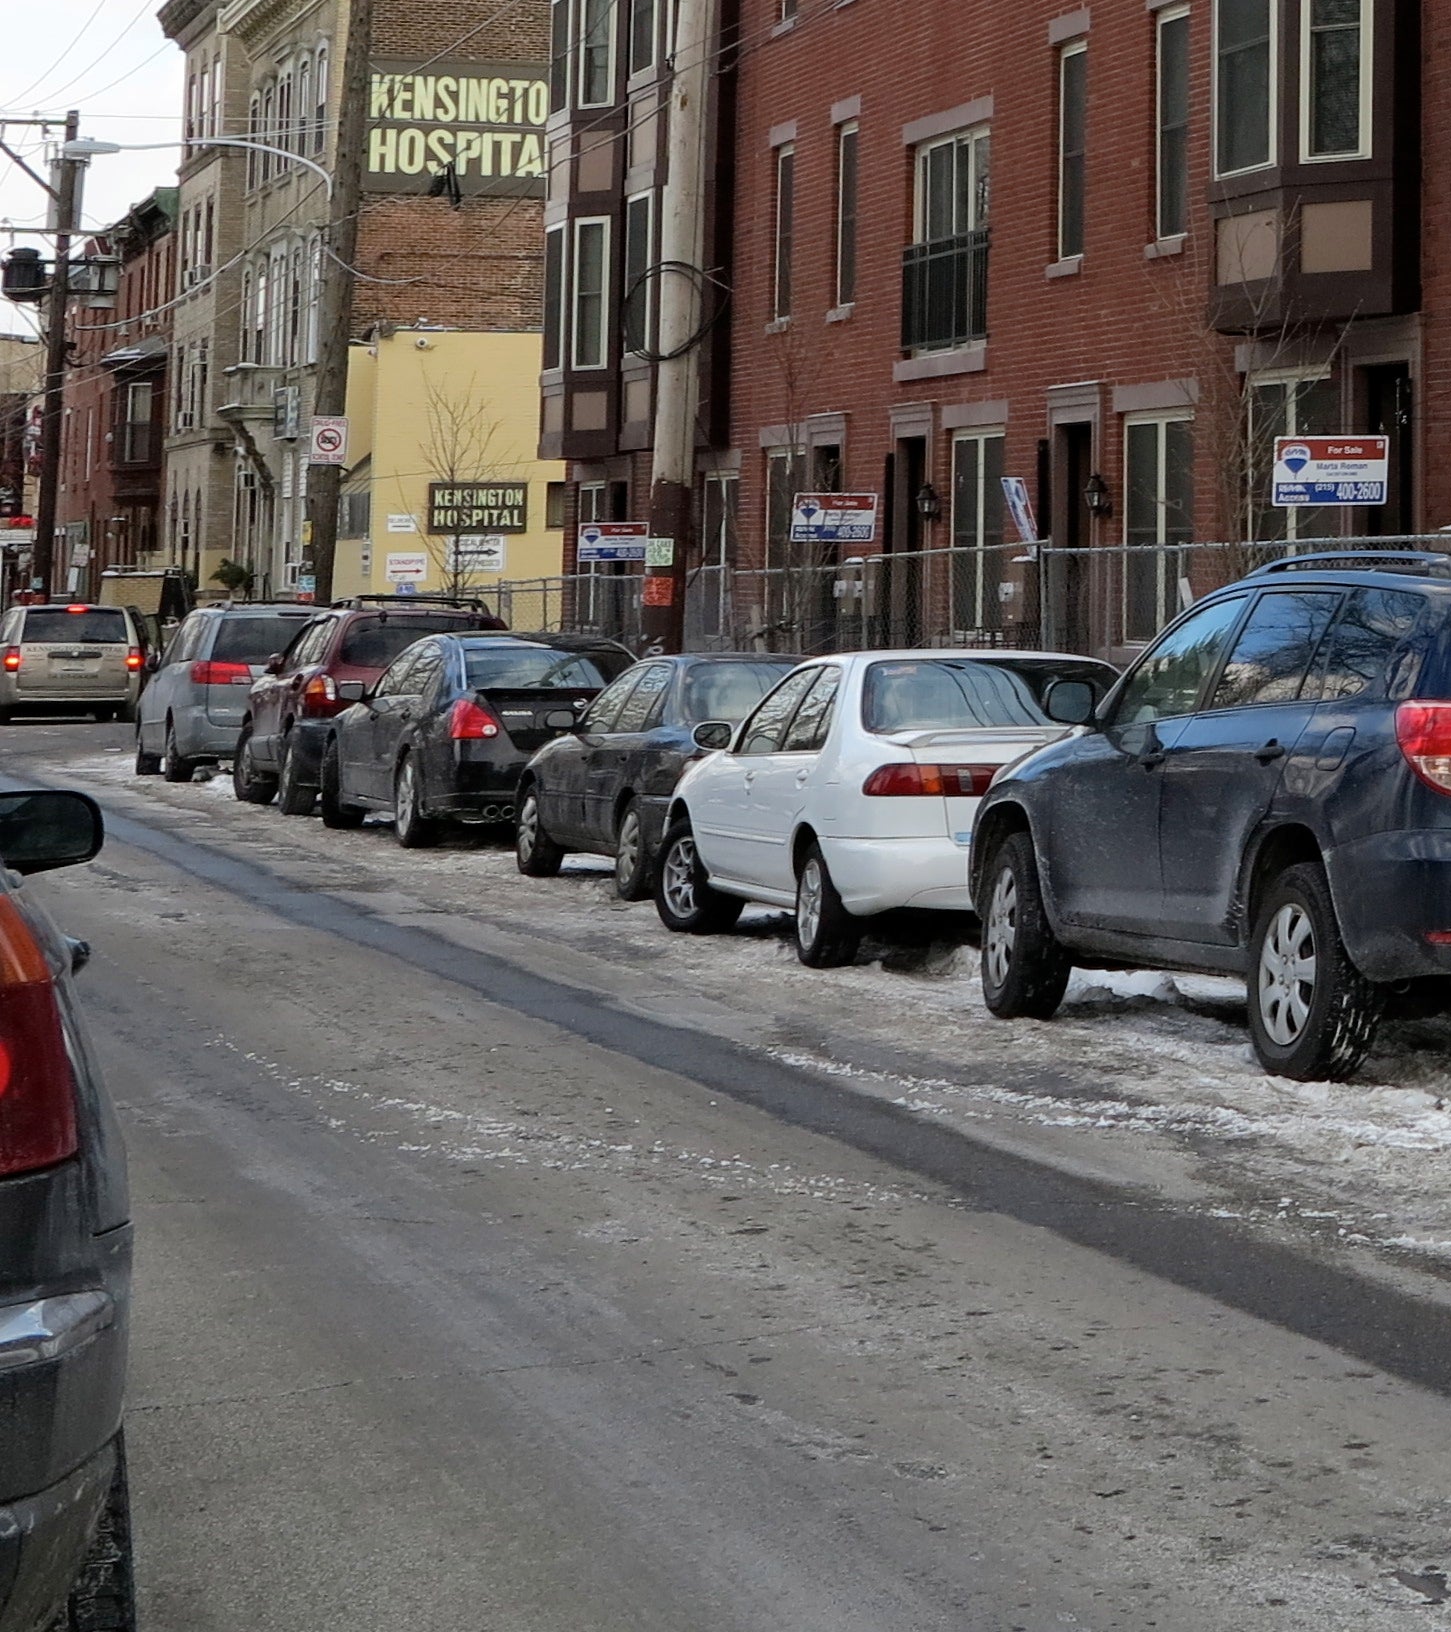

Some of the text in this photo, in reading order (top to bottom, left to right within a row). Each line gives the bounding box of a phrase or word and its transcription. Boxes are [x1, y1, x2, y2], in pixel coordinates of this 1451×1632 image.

[369, 73, 549, 126] KENSINGTO
[1327, 445, 1363, 455] For Sale
[434, 488, 523, 507] KENSINGTON
[1336, 482, 1381, 500] 400-2600
[433, 508, 523, 527] HOSPITAL
